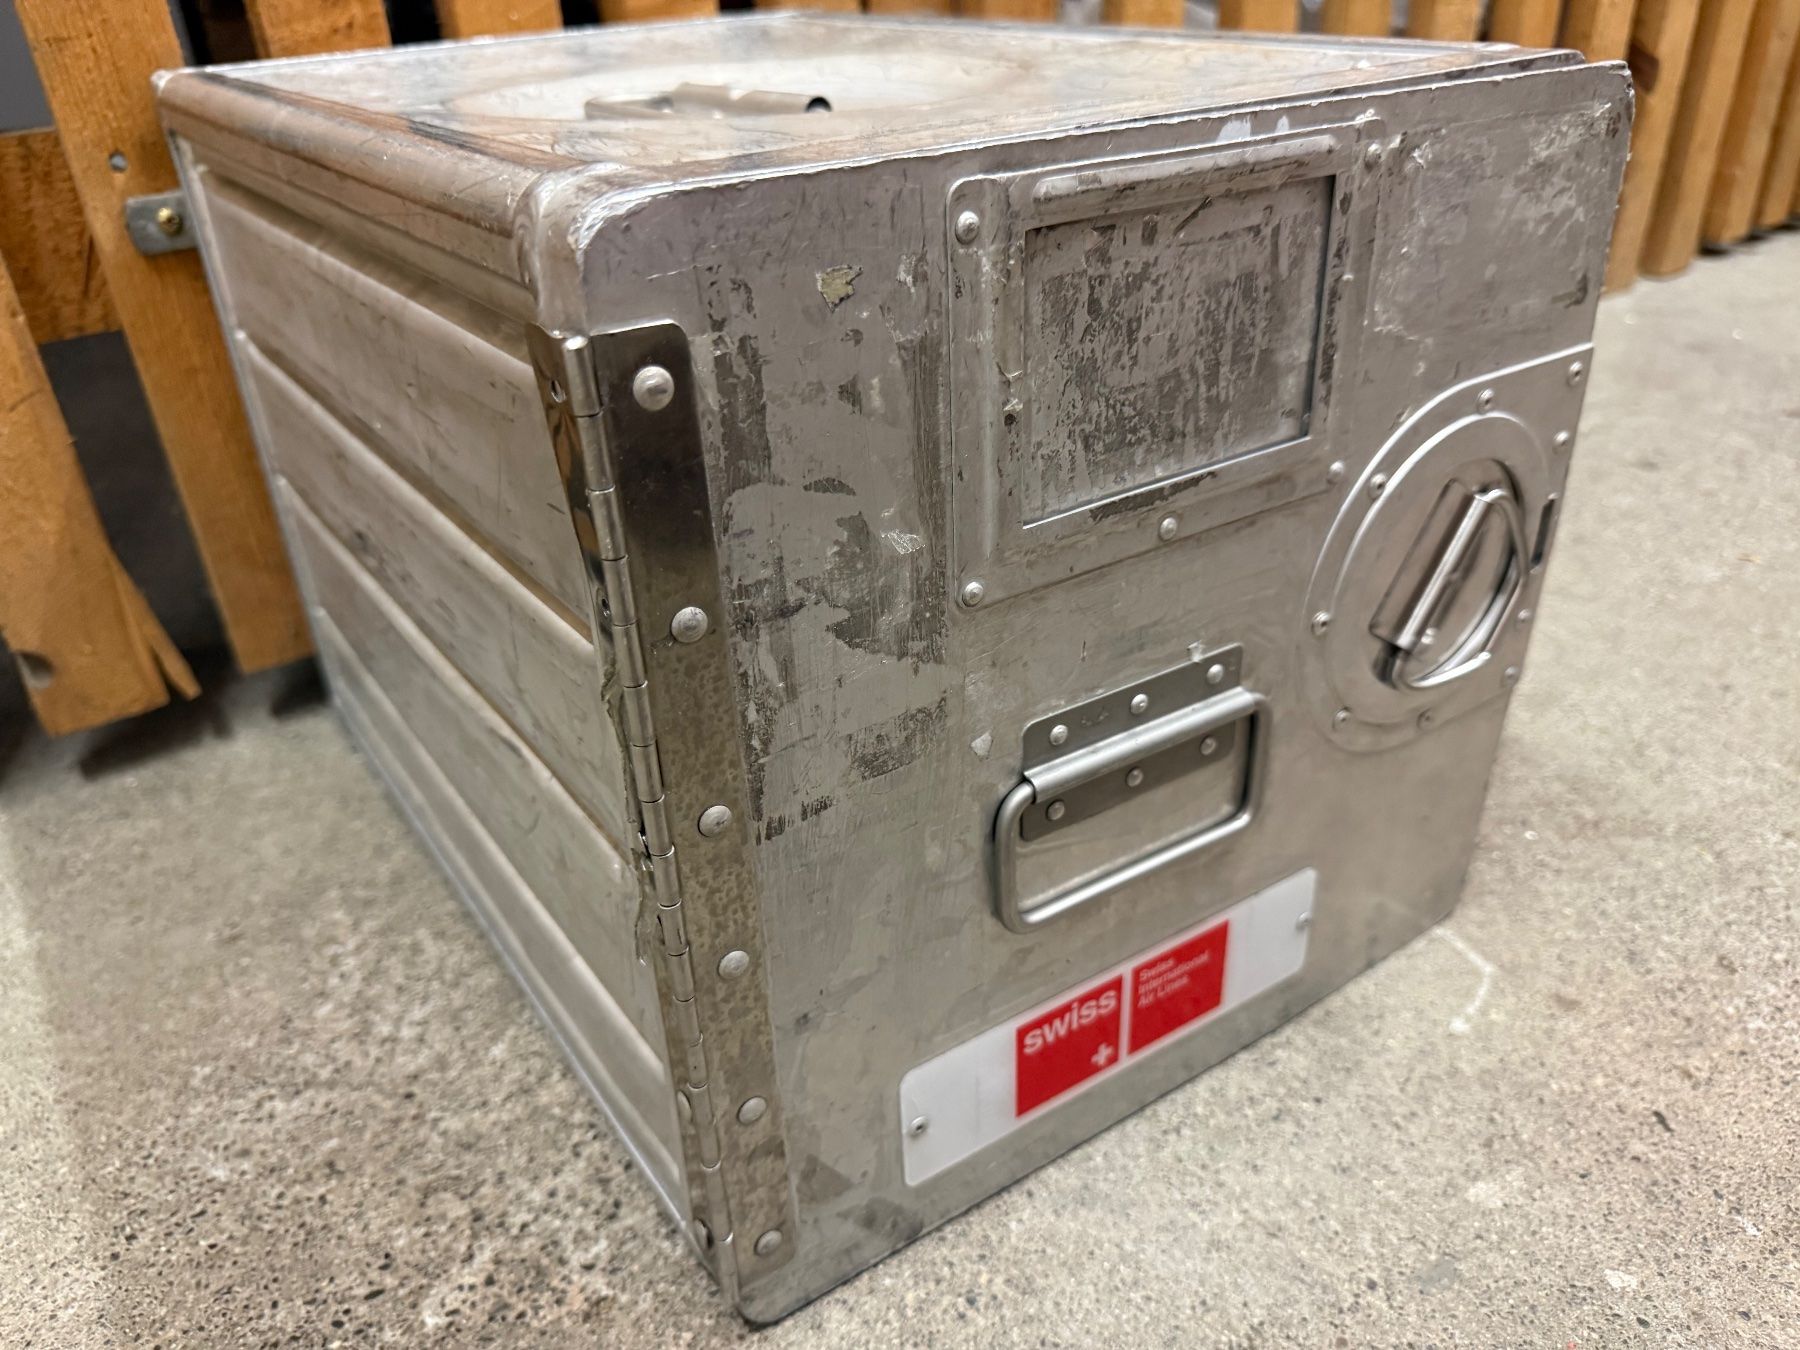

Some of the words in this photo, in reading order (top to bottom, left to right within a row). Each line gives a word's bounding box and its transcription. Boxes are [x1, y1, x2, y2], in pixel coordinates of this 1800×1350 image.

[1138, 950, 1208, 995] International
[1139, 957, 1174, 981] Swiss
[1138, 987, 1156, 1008] Air
[1157, 974, 1189, 998] Lines
[1023, 989, 1118, 1054] swiss
